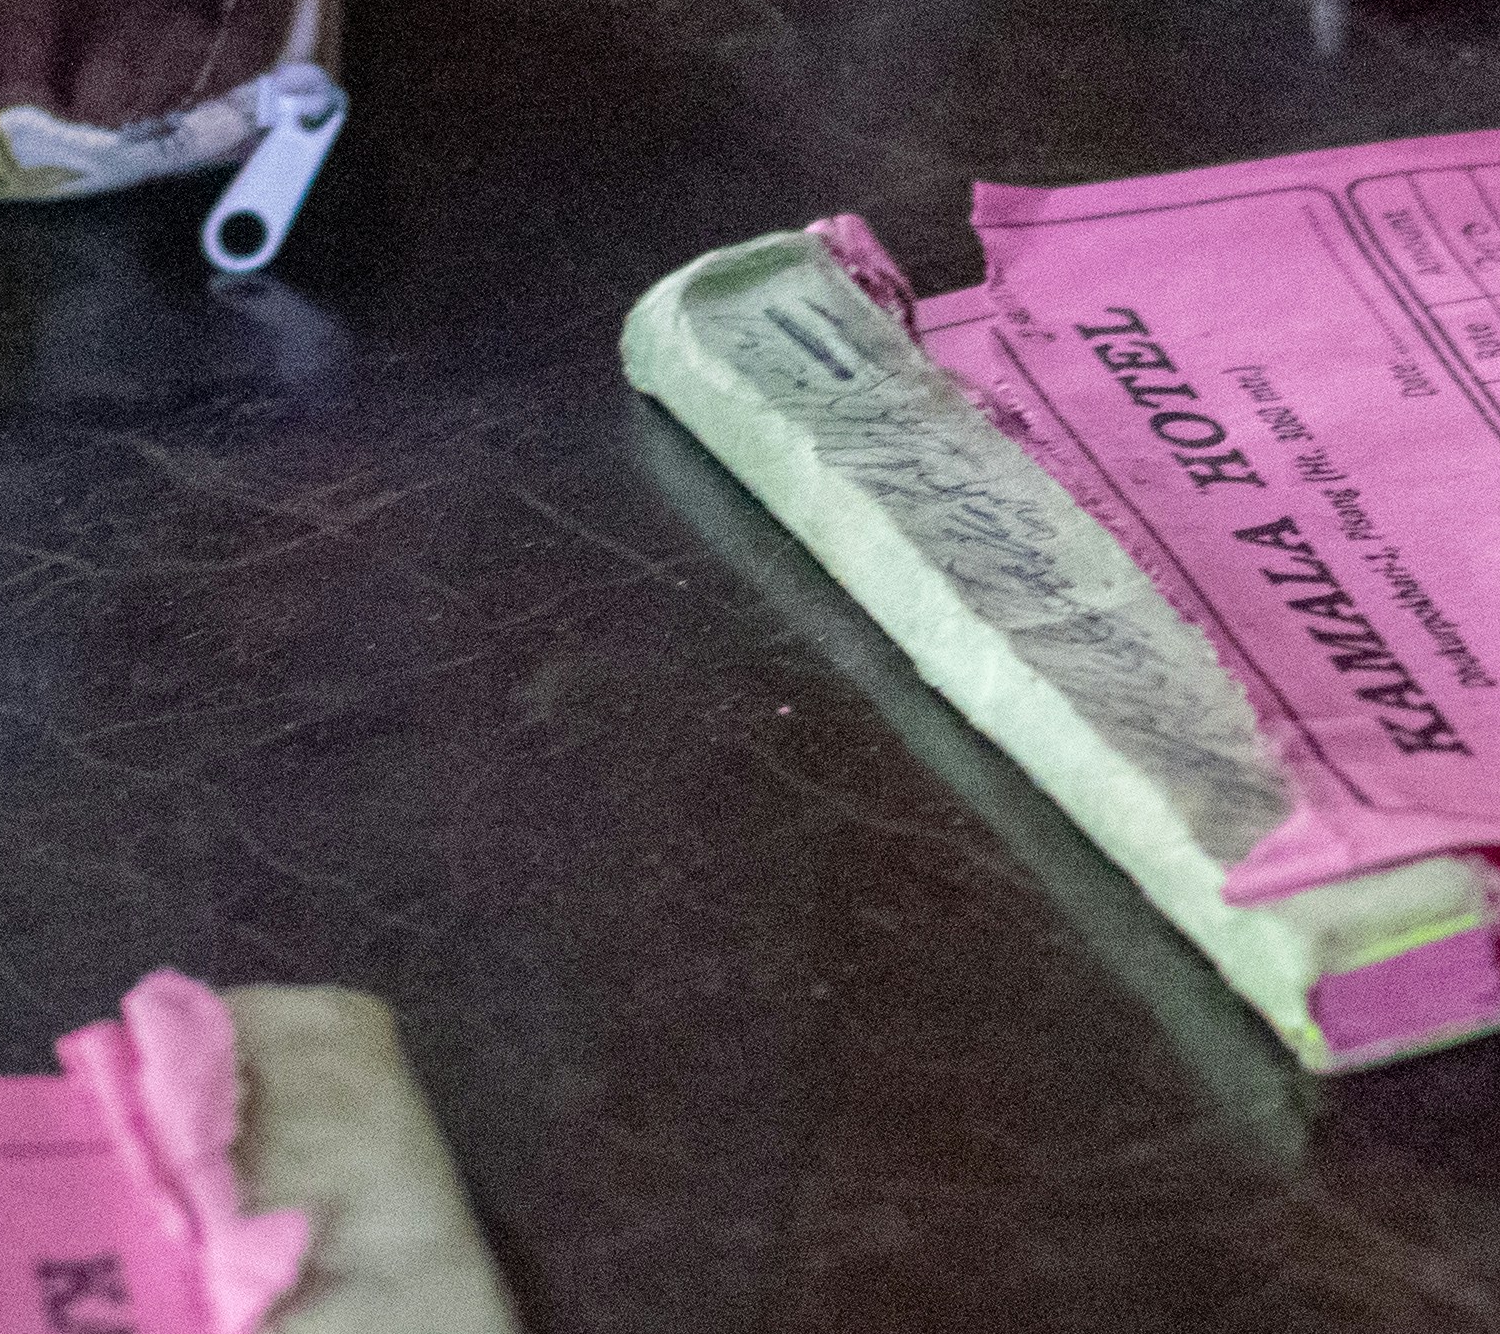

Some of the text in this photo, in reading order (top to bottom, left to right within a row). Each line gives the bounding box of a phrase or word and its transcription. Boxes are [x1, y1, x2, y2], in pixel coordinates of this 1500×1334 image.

[1384, 209, 1441, 275] Amount
[1074, 306, 1473, 758] KAMALA HOTEL
[1322, 487, 1381, 544] Pisang
